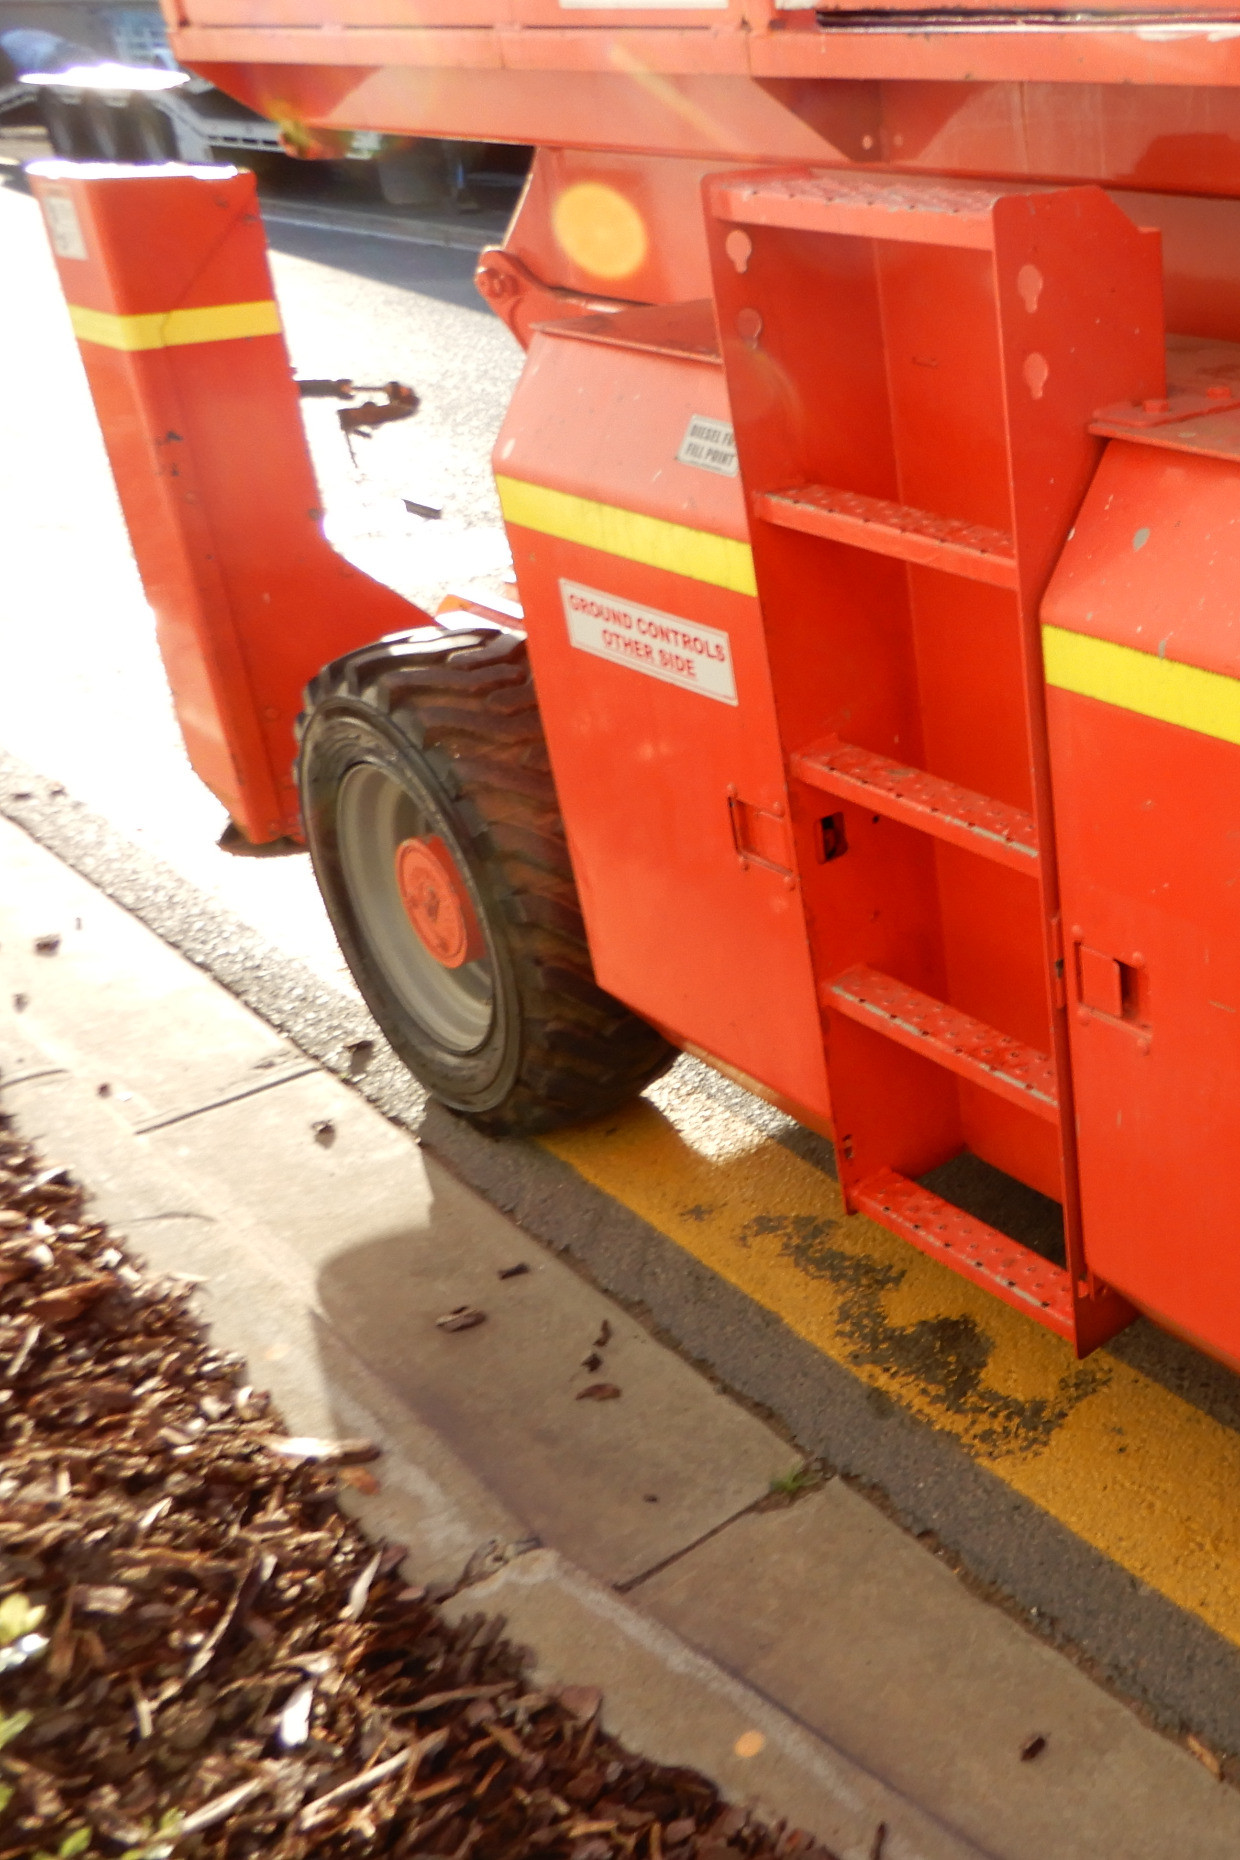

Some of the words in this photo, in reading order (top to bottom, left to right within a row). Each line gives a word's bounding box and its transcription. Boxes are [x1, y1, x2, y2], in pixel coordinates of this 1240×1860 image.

[690, 423, 721, 443] DIESEL
[704, 448, 735, 467] POINT
[569, 593, 633, 630] GROUND
[636, 617, 725, 662] CONTROLS
[602, 628, 653, 660] OTHER
[659, 649, 697, 678] SIDE
